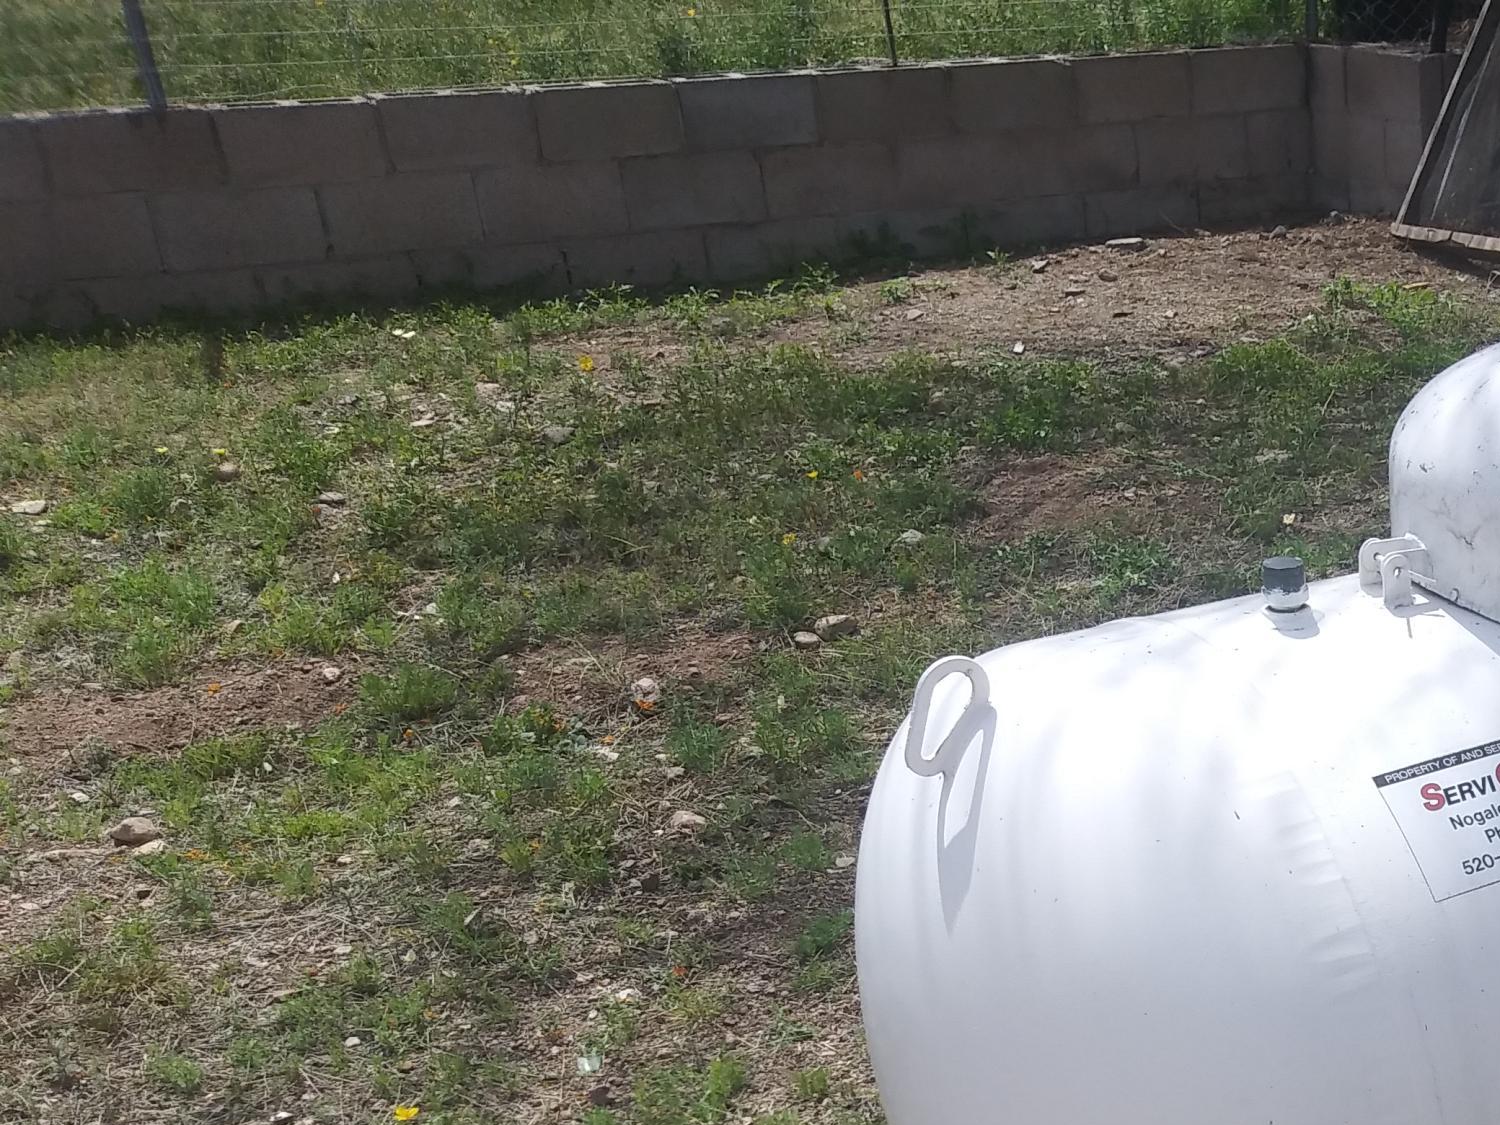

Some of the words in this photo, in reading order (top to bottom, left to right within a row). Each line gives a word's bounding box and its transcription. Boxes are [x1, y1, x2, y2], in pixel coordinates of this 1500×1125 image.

[1384, 760, 1440, 783] PROPERTY
[1442, 755, 1458, 767] OF
[1461, 748, 1484, 762] AND
